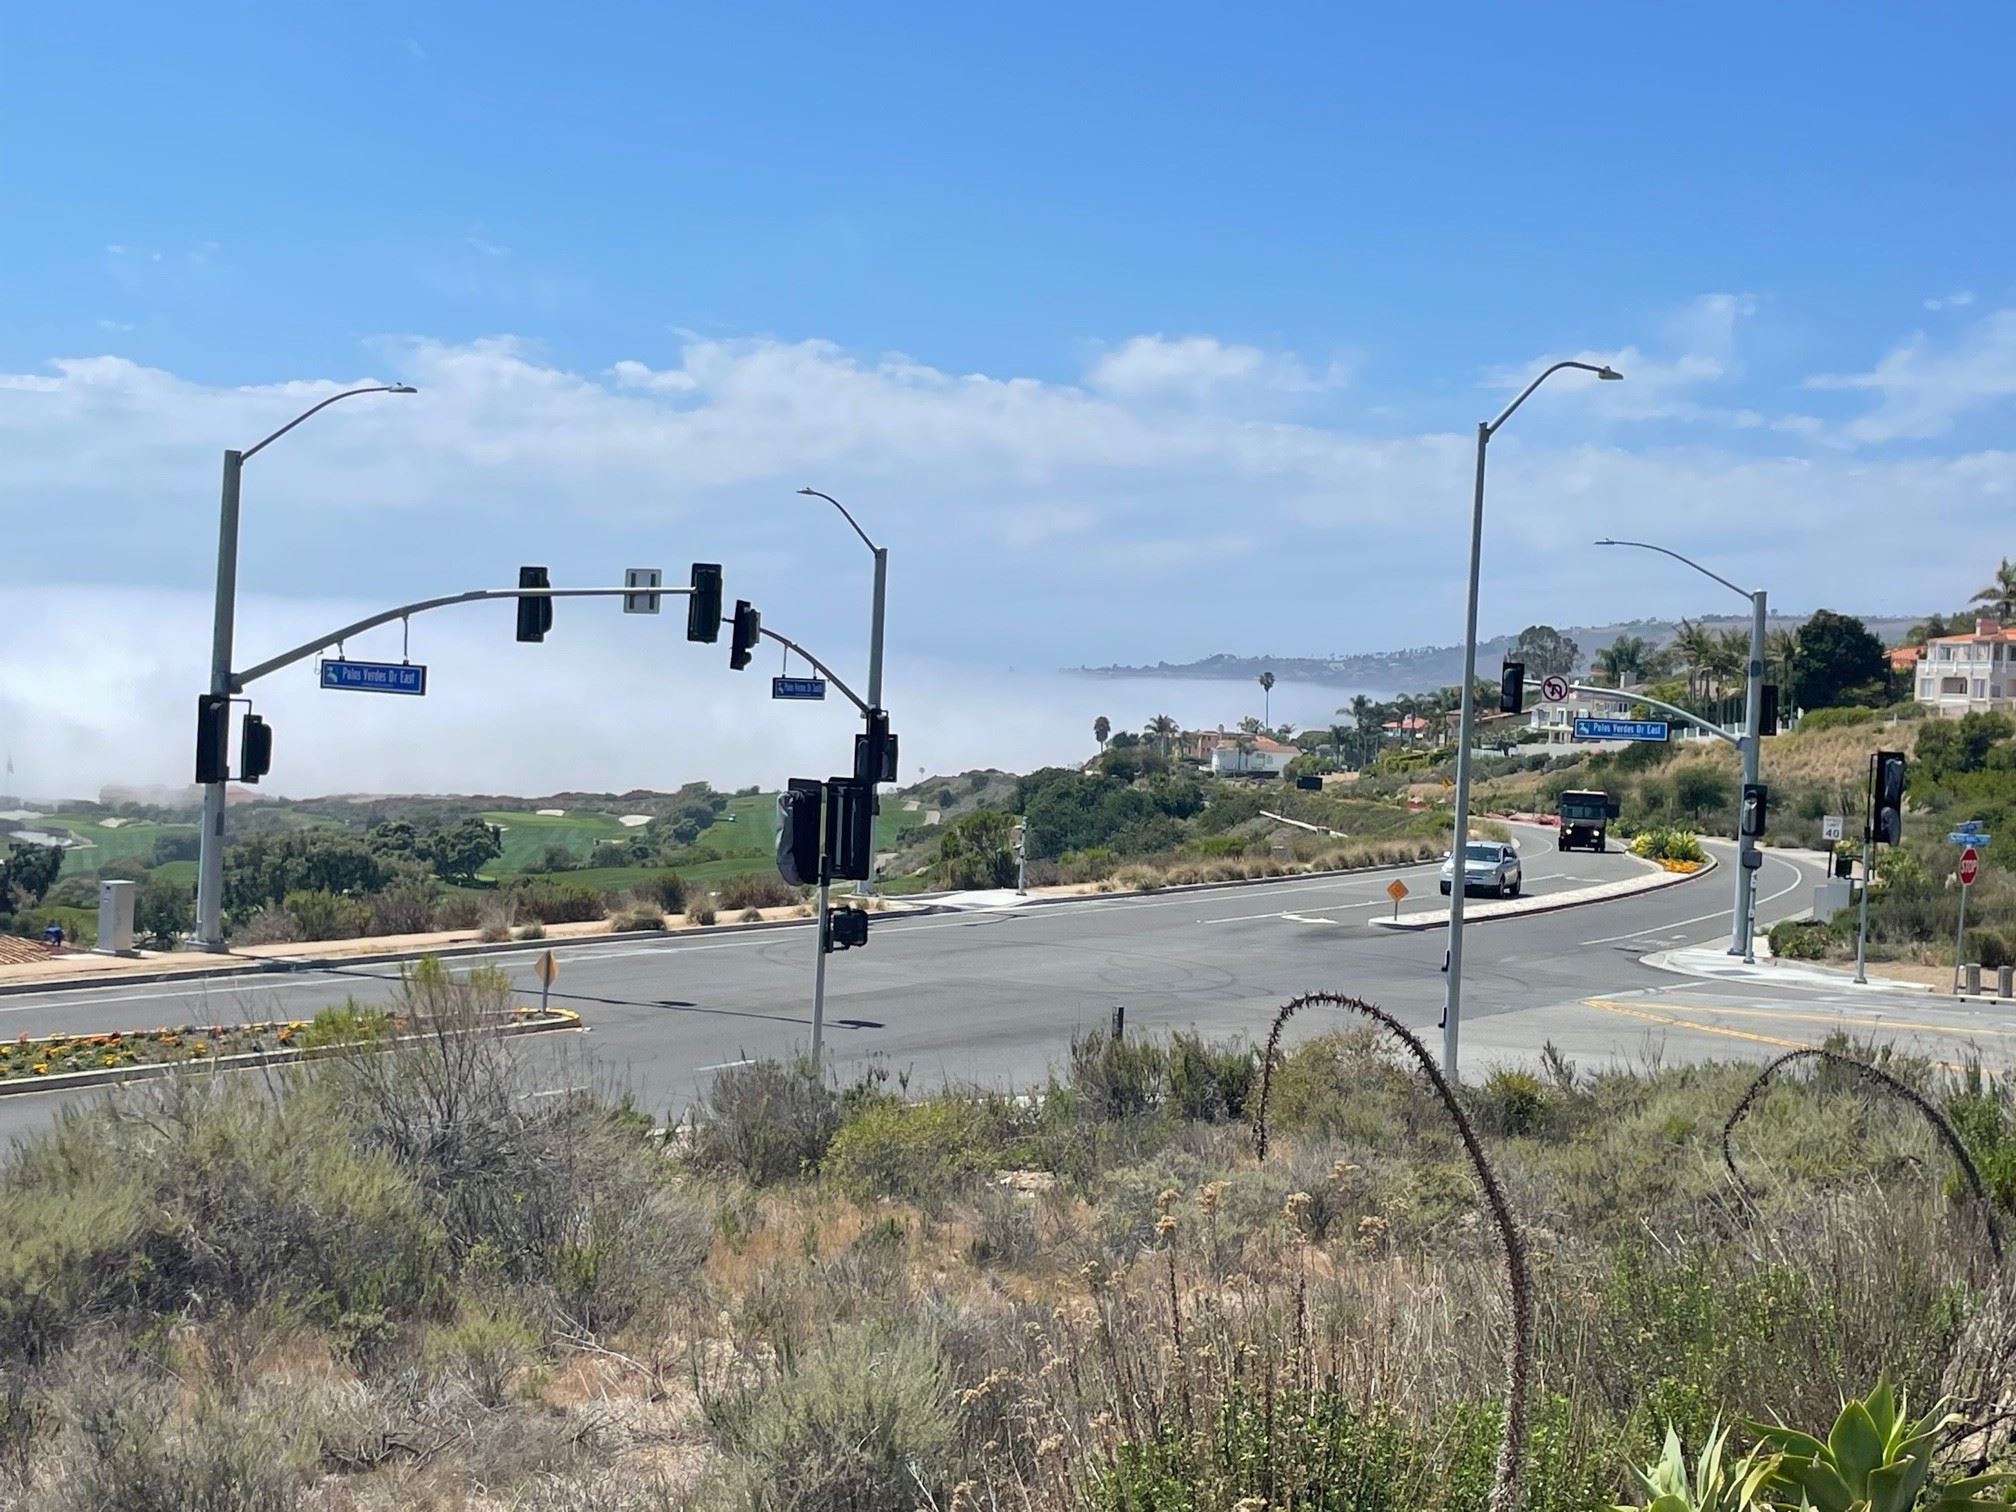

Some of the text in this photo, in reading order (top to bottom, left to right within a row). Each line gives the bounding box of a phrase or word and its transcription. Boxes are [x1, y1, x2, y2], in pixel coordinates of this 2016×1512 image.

[342, 667, 415, 684] Palos Verdes Dr East
[1593, 722, 1661, 735] Palos Verdes Dr East
[1825, 829, 1840, 838] 40
[1961, 860, 1977, 874] STOP
